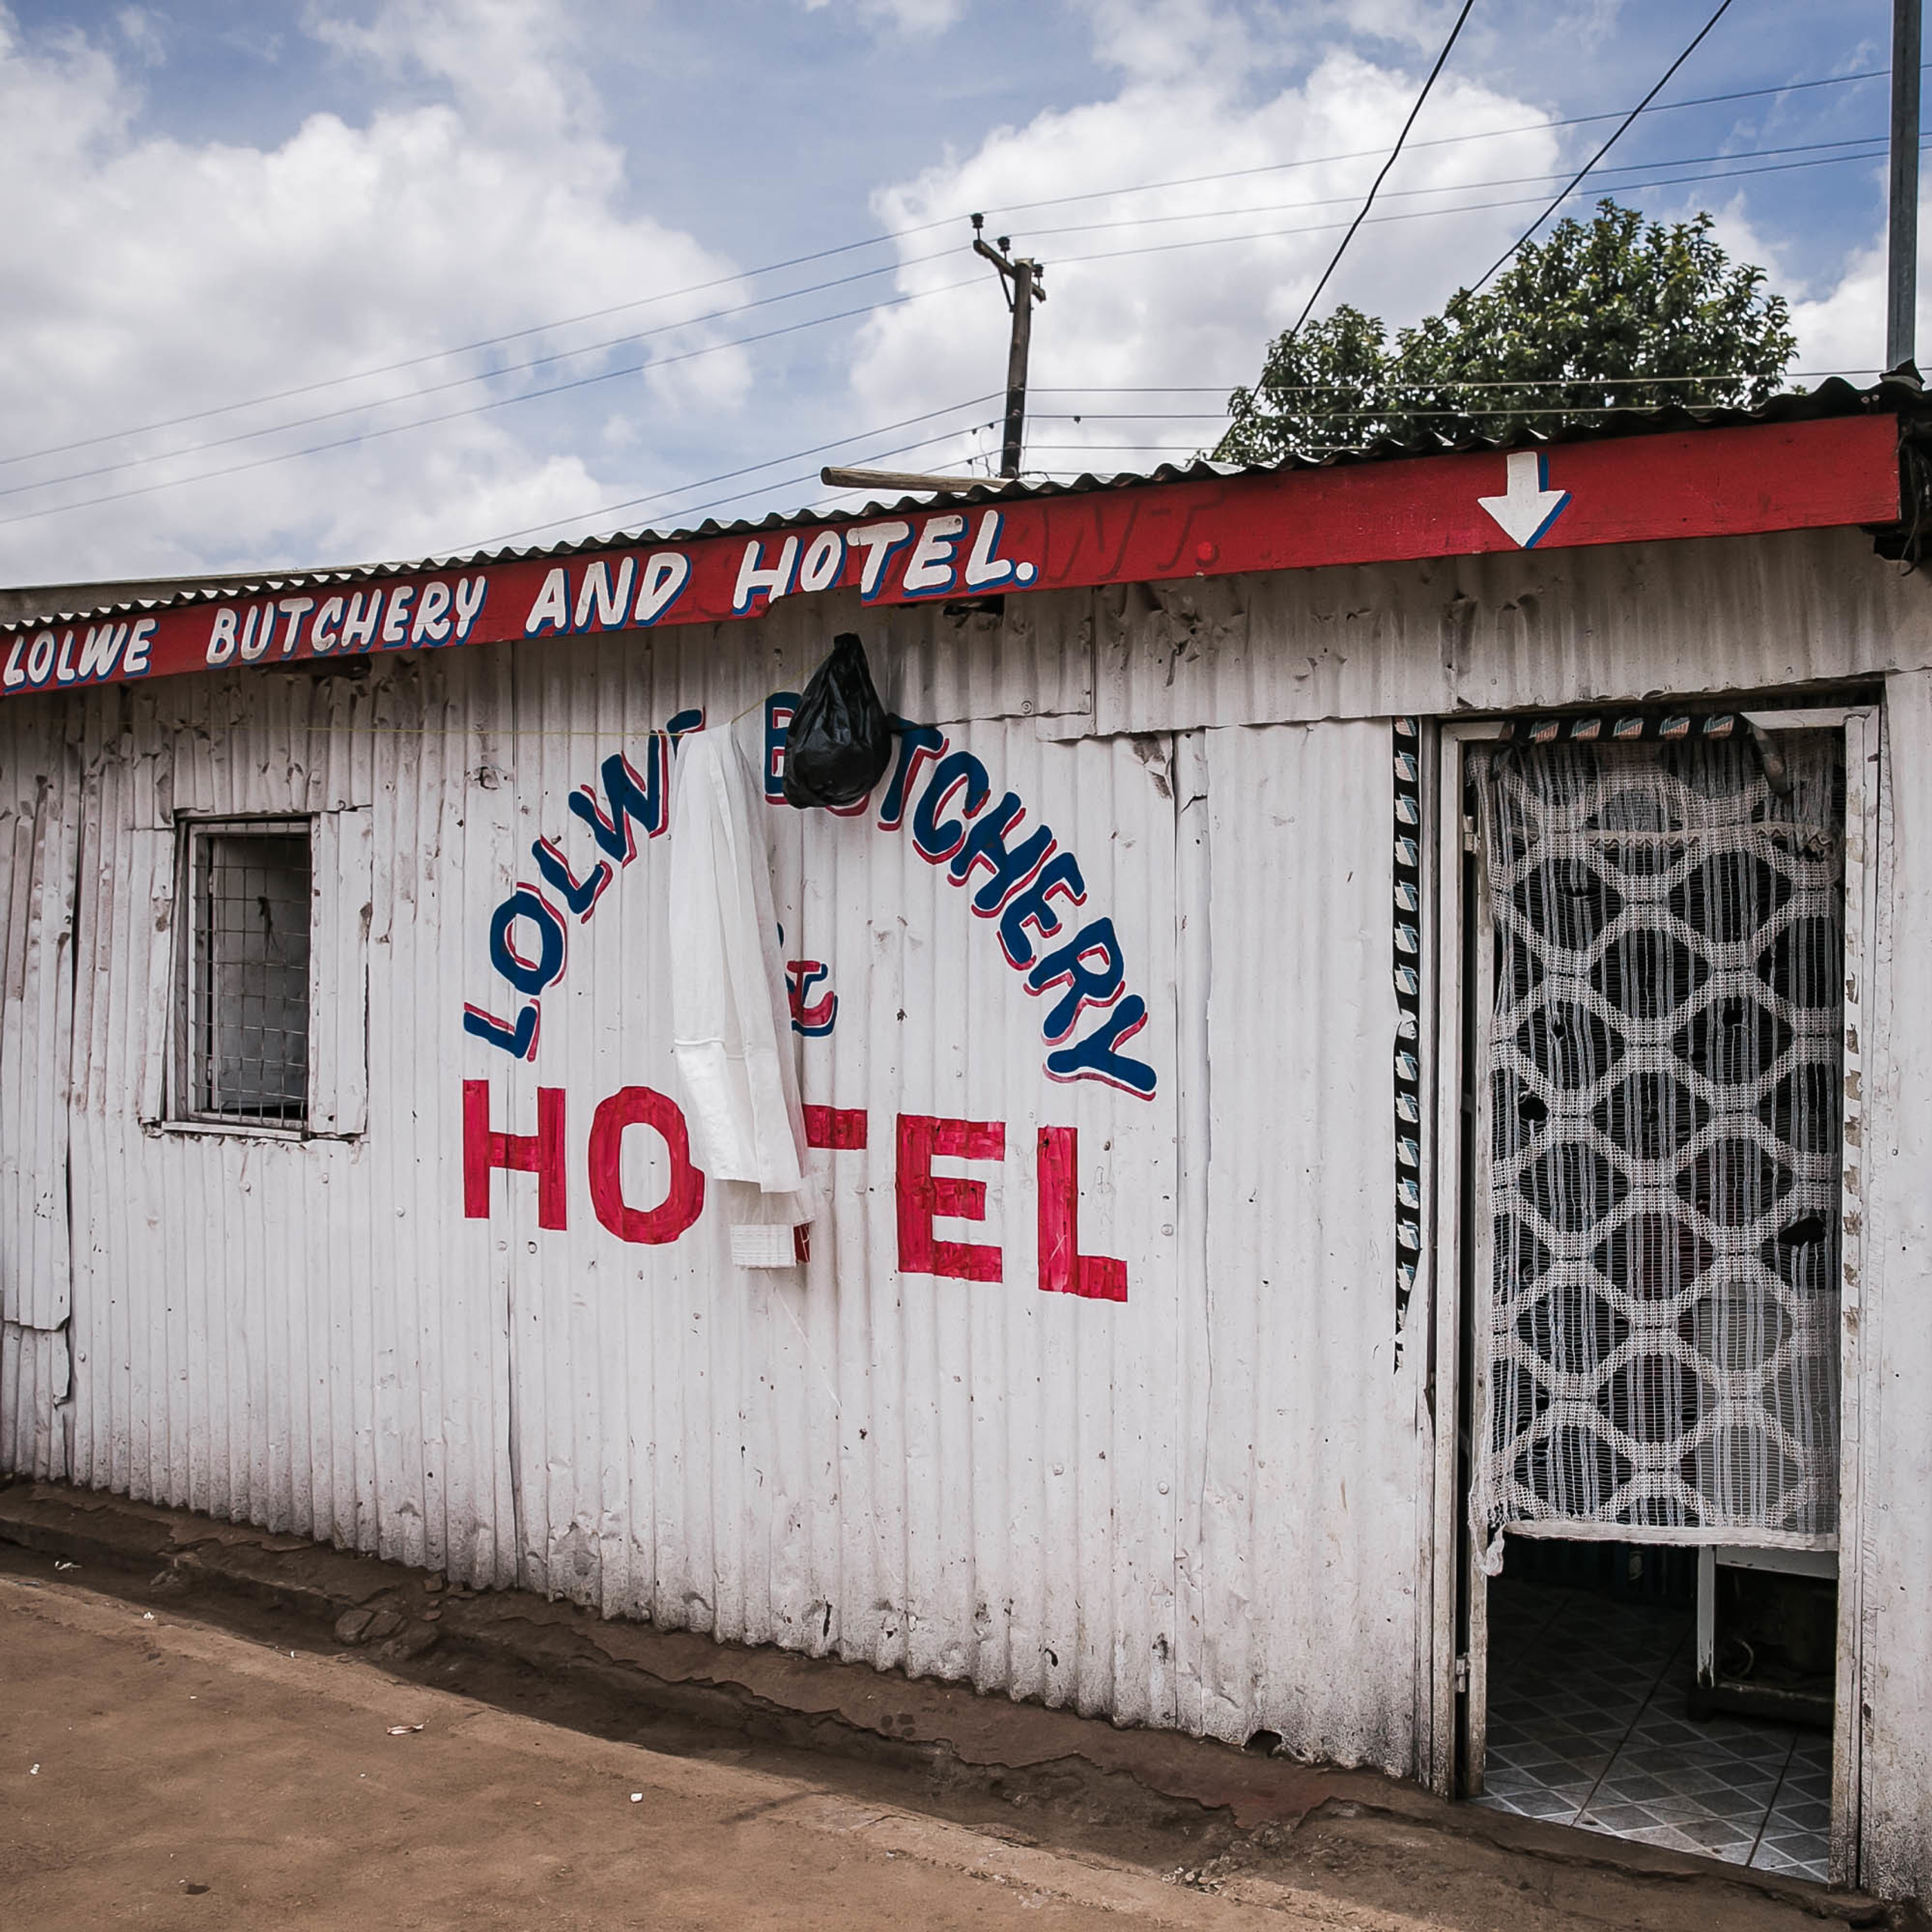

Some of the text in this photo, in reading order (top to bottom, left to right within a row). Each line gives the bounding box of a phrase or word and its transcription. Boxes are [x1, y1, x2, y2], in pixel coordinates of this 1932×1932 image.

[2, 618, 160, 694] LOLWE
[205, 574, 489, 669] BUTCHERY
[525, 552, 691, 638] AND
[732, 509, 1038, 616] HOTEL.
